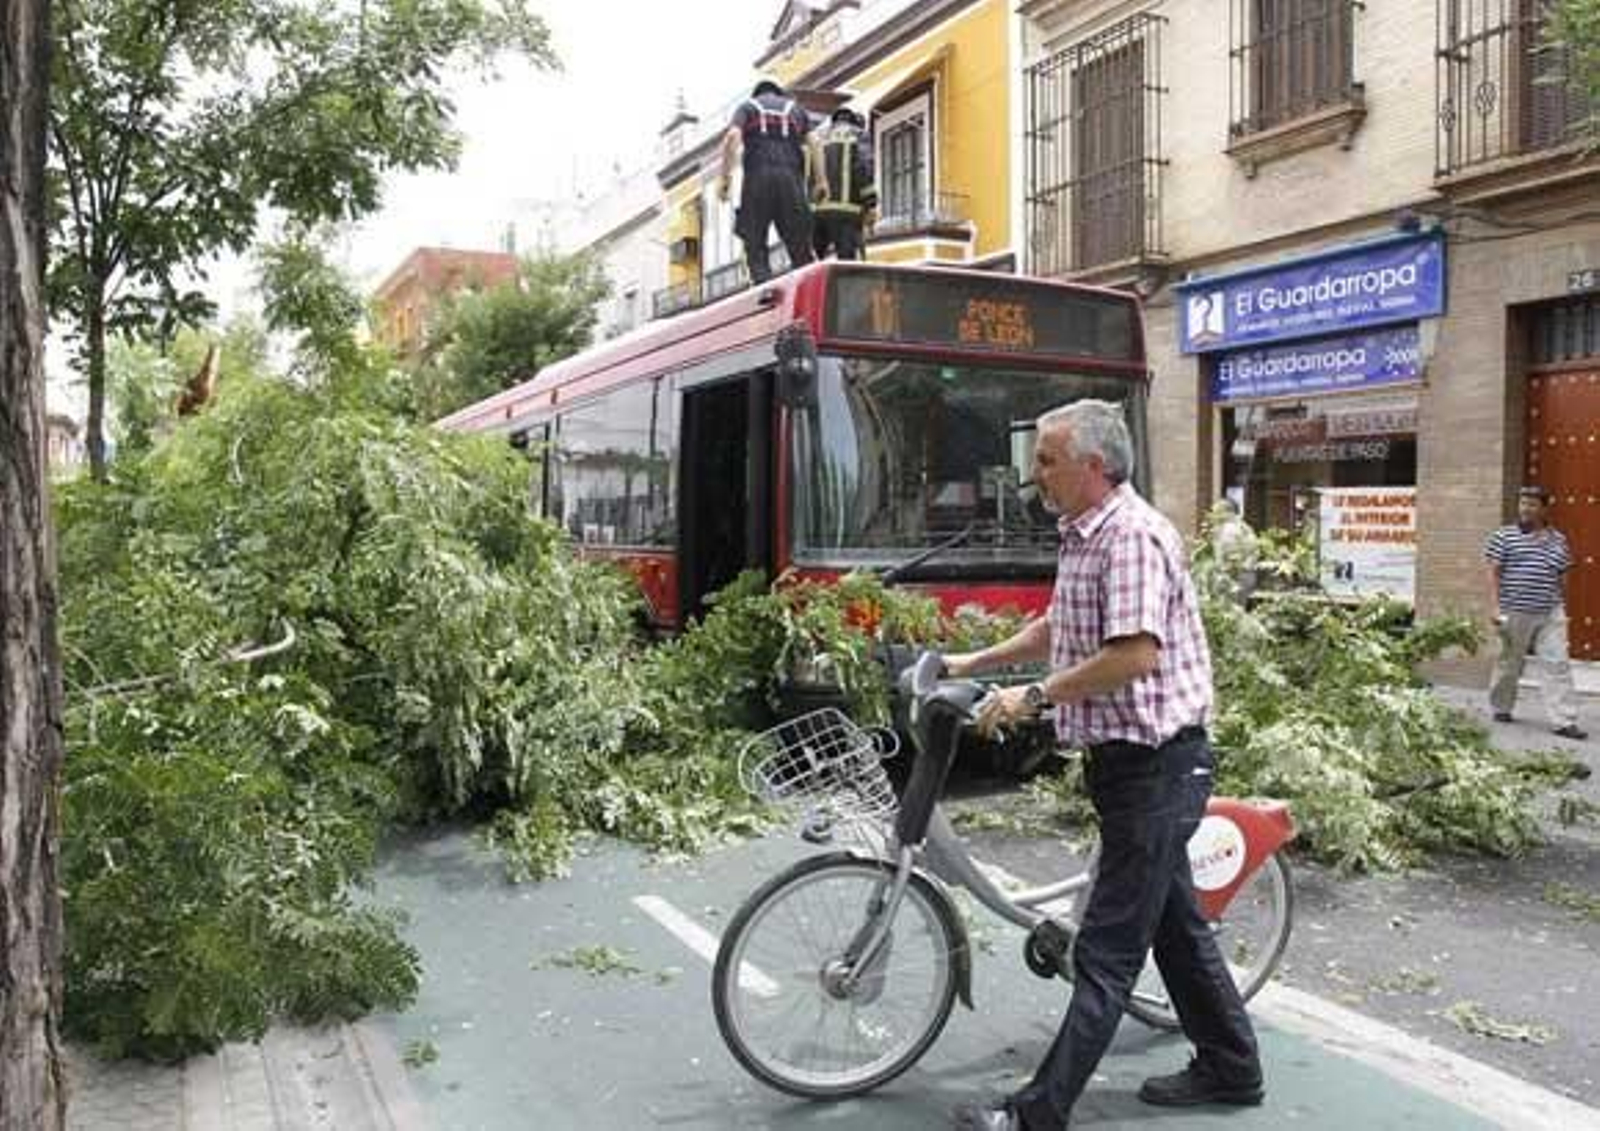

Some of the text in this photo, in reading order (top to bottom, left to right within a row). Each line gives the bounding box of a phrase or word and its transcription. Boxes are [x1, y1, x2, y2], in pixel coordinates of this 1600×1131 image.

[1236, 292, 1252, 317] El
[1258, 263, 1416, 311] Guardarropa
[968, 298, 1026, 323] PONCE
[958, 319, 981, 343] DE
[1219, 361, 1233, 382] El
[1237, 348, 1366, 380] Guardarropa
